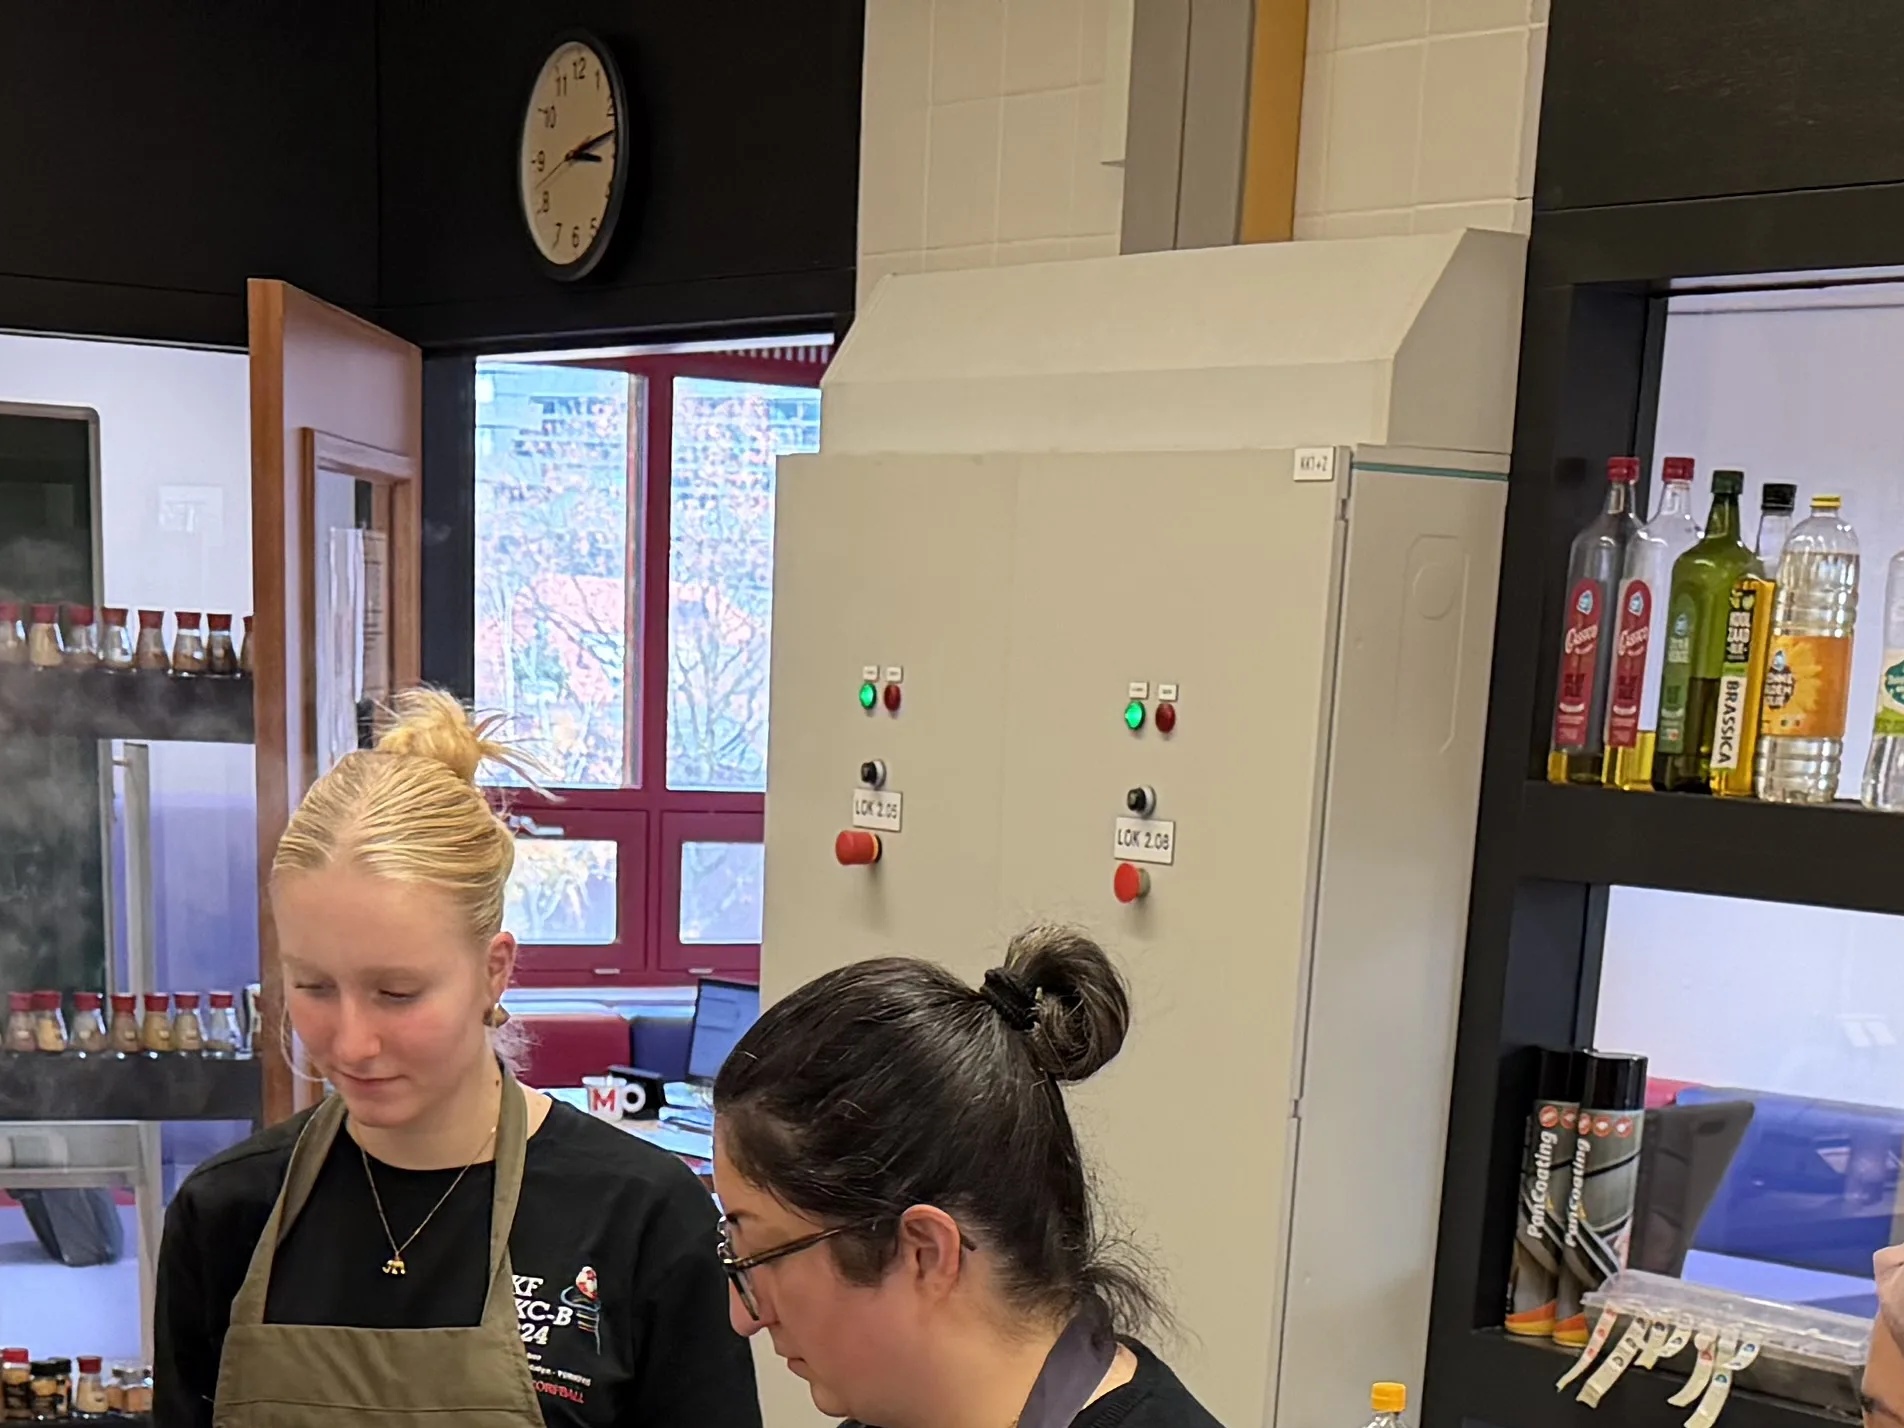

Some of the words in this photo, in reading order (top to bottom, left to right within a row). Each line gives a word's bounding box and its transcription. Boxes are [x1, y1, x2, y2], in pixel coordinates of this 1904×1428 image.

[572, 57, 587, 79] 12
[556, 76, 567, 97] 11
[595, 69, 601, 90] 1
[543, 105, 556, 128] 10
[536, 151, 546, 172] 9
[542, 190, 550, 213] 8
[554, 222, 563, 245] 7
[571, 225, 580, 248] 6
[589, 217, 598, 238] 5
[1718, 680, 1740, 764] BRASSICA
[856, 799, 874, 816] LOK
[1117, 829, 1141, 847] LOK
[1526, 1130, 1558, 1239] PanCoating
[1564, 1137, 1591, 1248] PanCoating
